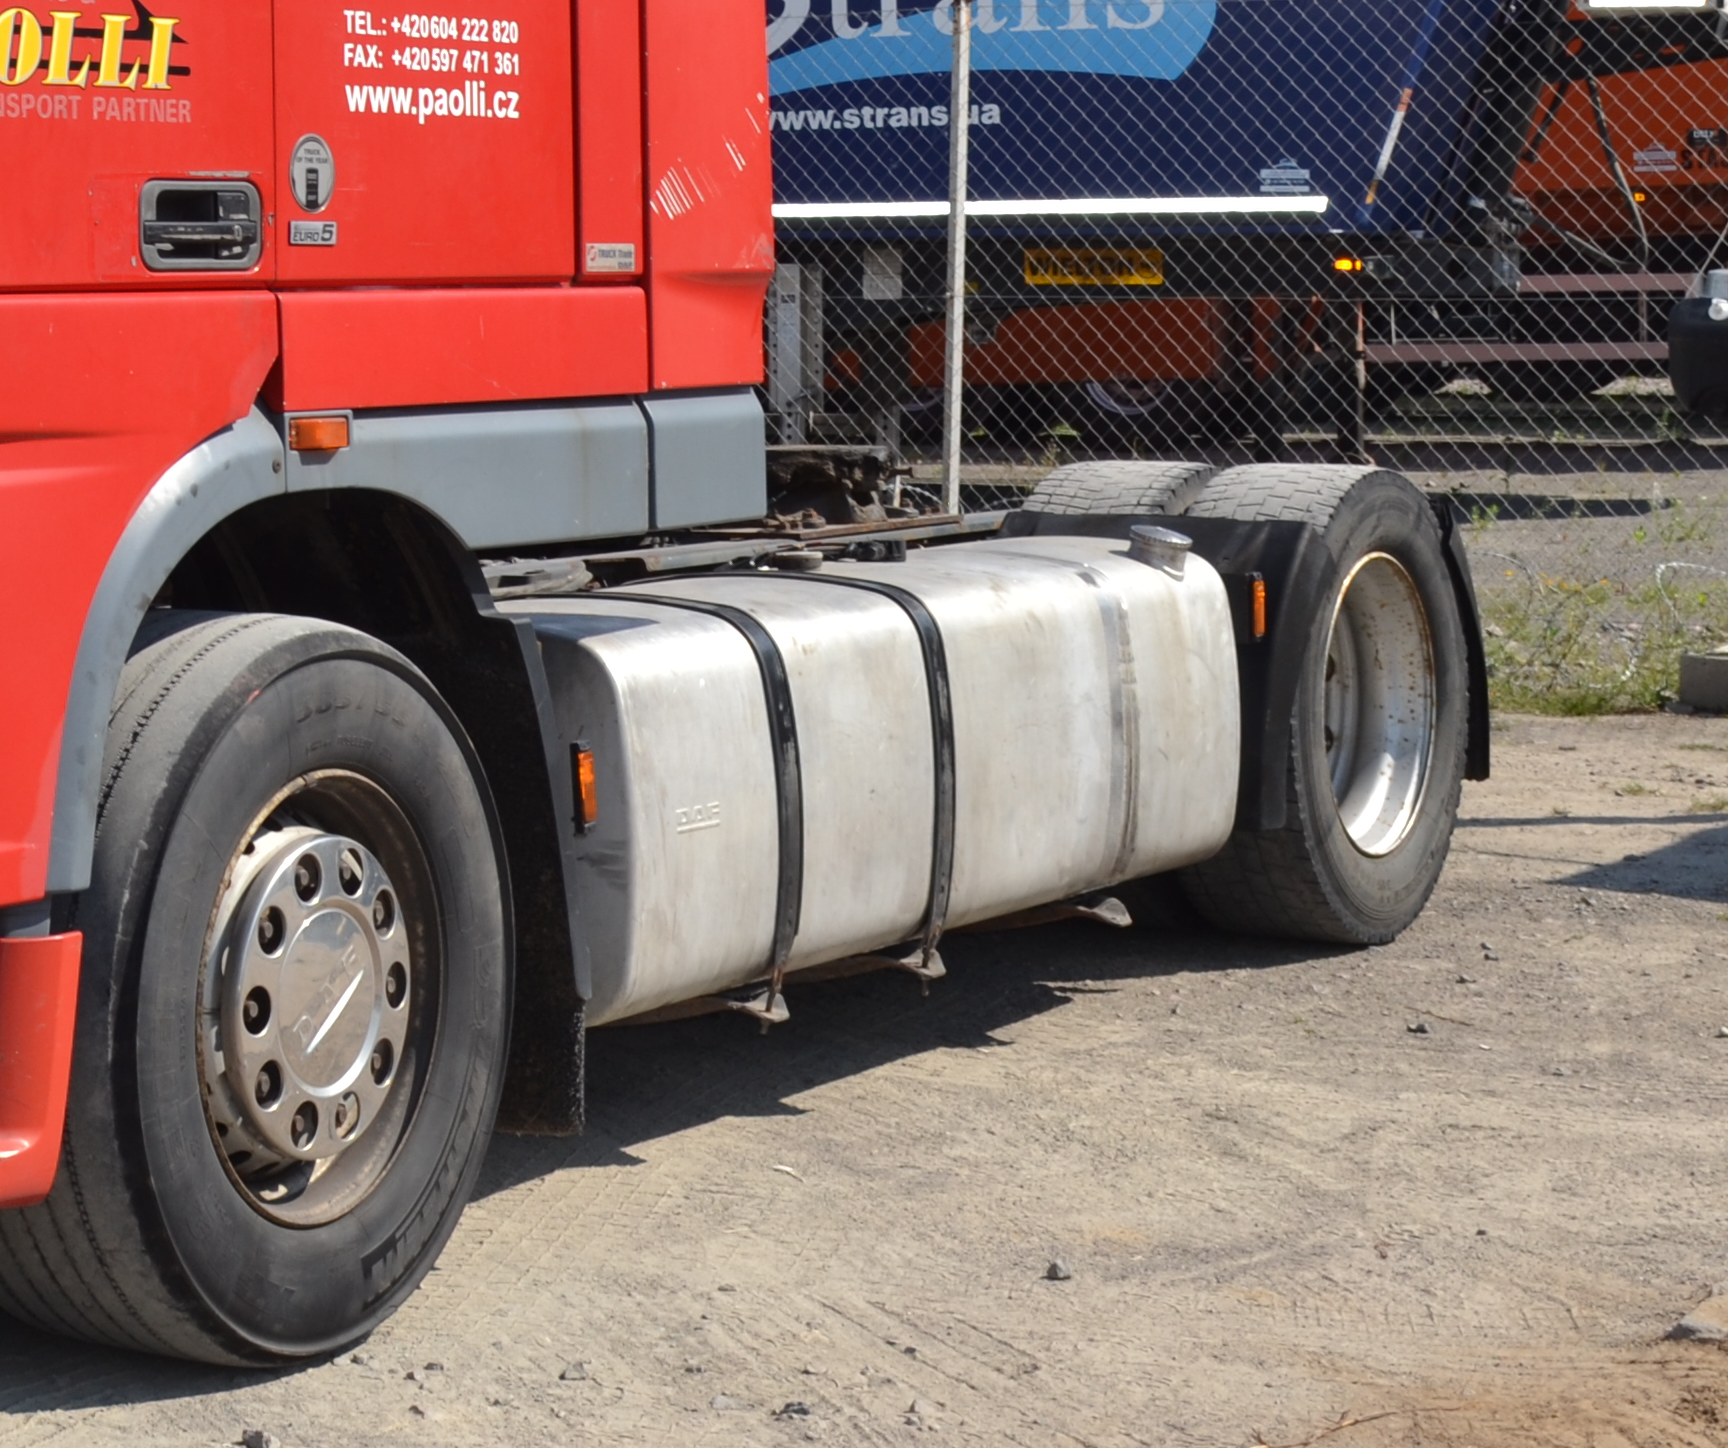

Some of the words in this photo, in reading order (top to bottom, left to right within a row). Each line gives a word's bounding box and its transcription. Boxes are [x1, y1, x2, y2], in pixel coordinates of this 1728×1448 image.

[343, 9, 388, 37] TEL.:
[461, 17, 489, 42] 222
[492, 19, 519, 44] 820
[343, 42, 384, 69] FAX:
[462, 49, 489, 74] 471
[494, 51, 520, 76] 361
[92, 96, 193, 124] PARTNER
[344, 79, 520, 125] www.paolli.cz
[768, 103, 1001, 132] ww.stransua
[292, 231, 320, 242] EURO
[320, 223, 334, 242] 5
